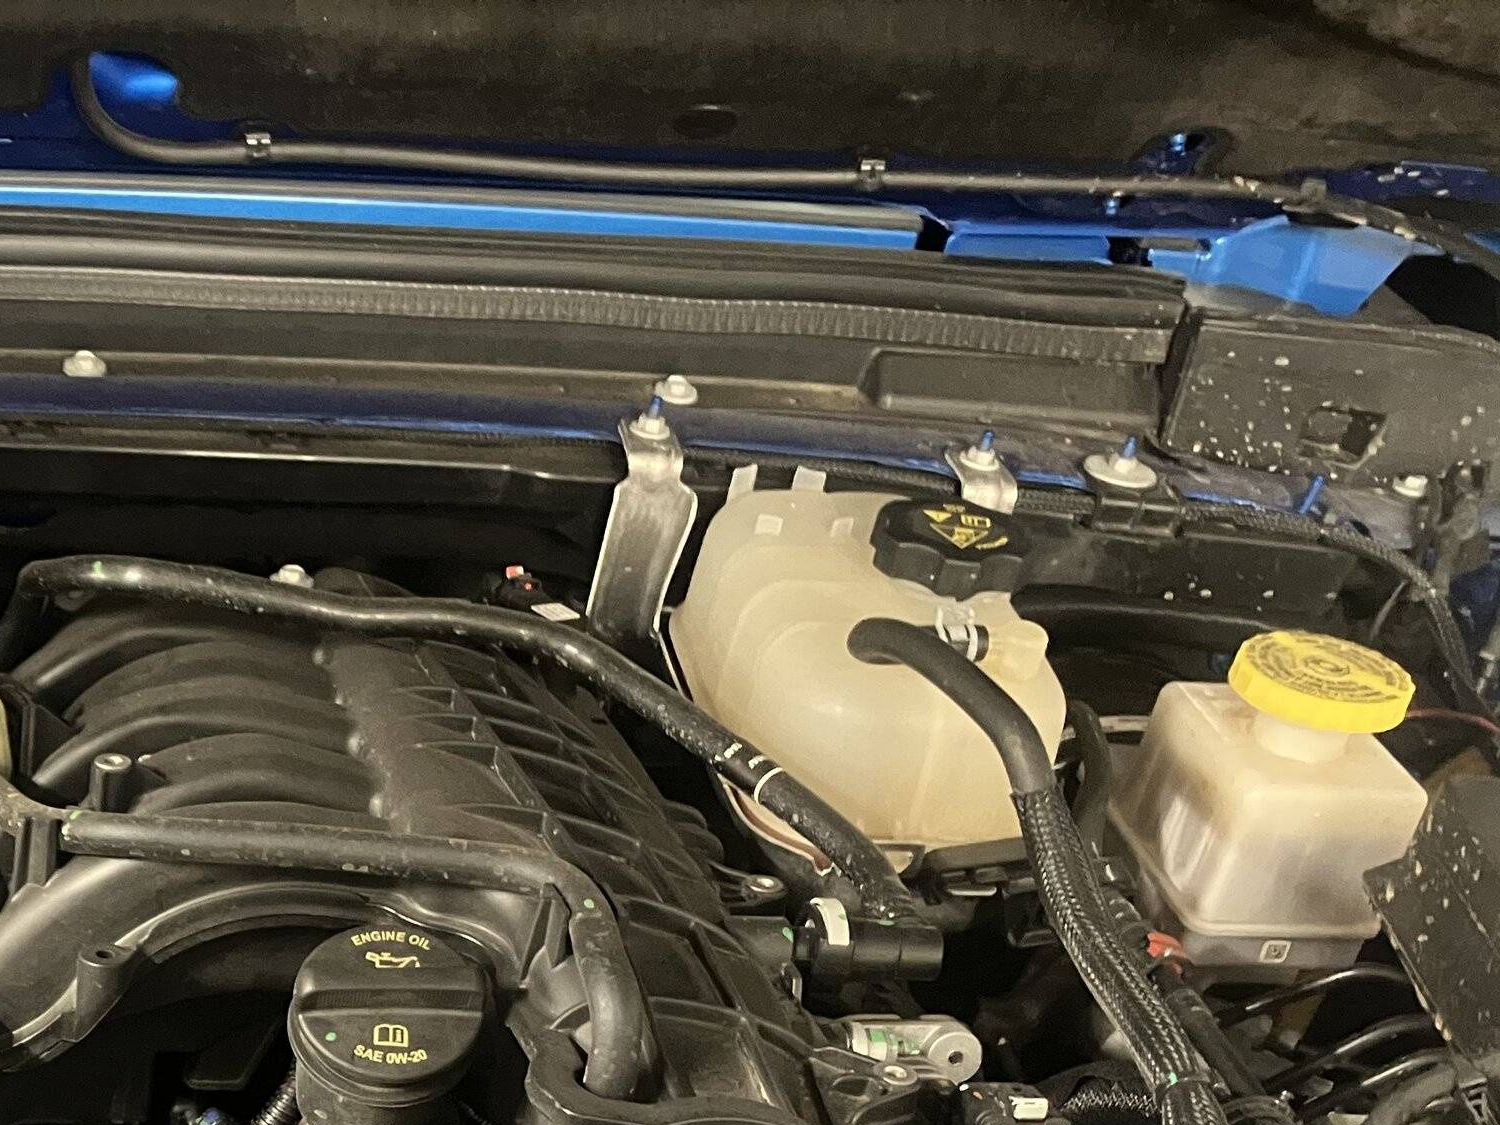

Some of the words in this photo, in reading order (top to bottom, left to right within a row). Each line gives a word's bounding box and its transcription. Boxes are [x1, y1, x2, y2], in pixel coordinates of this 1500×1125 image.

[350, 930, 406, 947] ENGINE
[408, 934, 432, 951] OIL
[353, 1044, 382, 1063] SAE
[385, 1048, 428, 1065] 0W-20
